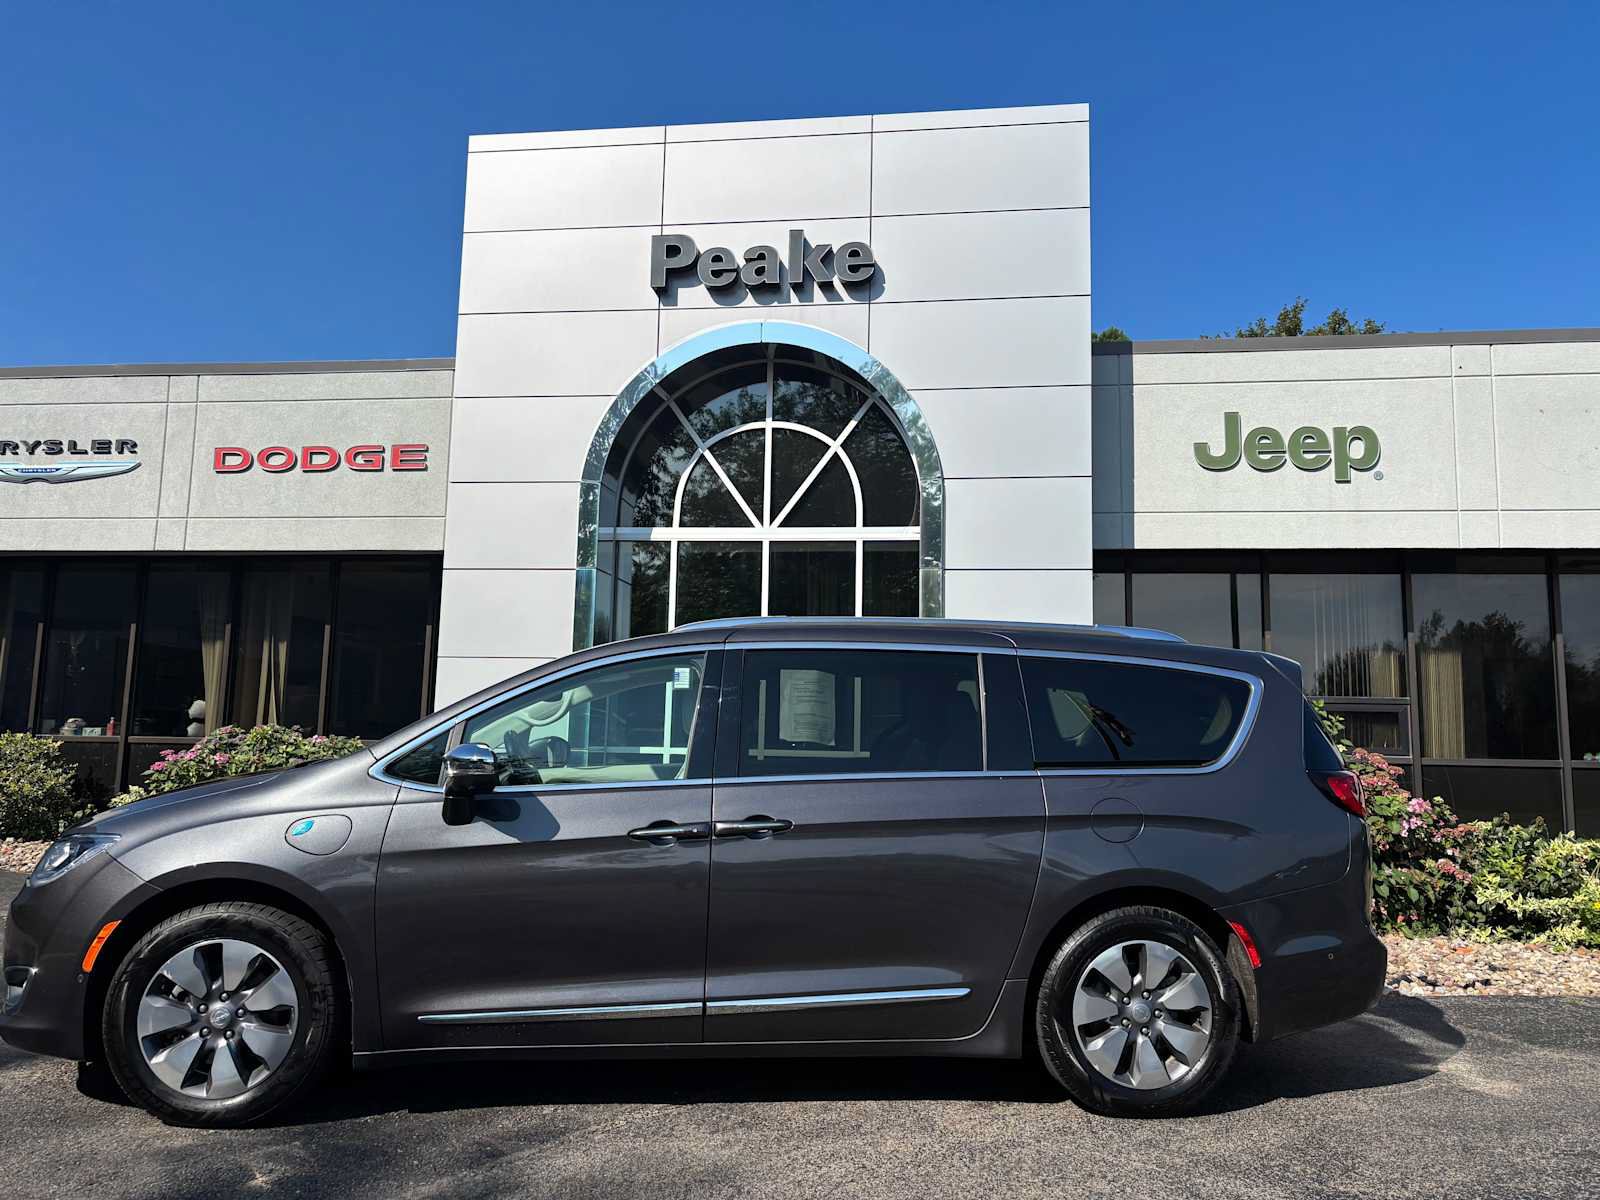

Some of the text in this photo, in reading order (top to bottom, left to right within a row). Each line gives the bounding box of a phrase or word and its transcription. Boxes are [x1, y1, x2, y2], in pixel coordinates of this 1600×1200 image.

[651, 229, 876, 289] Peake
[213, 443, 428, 473] DODGE
[1193, 411, 1381, 484] Jeep
